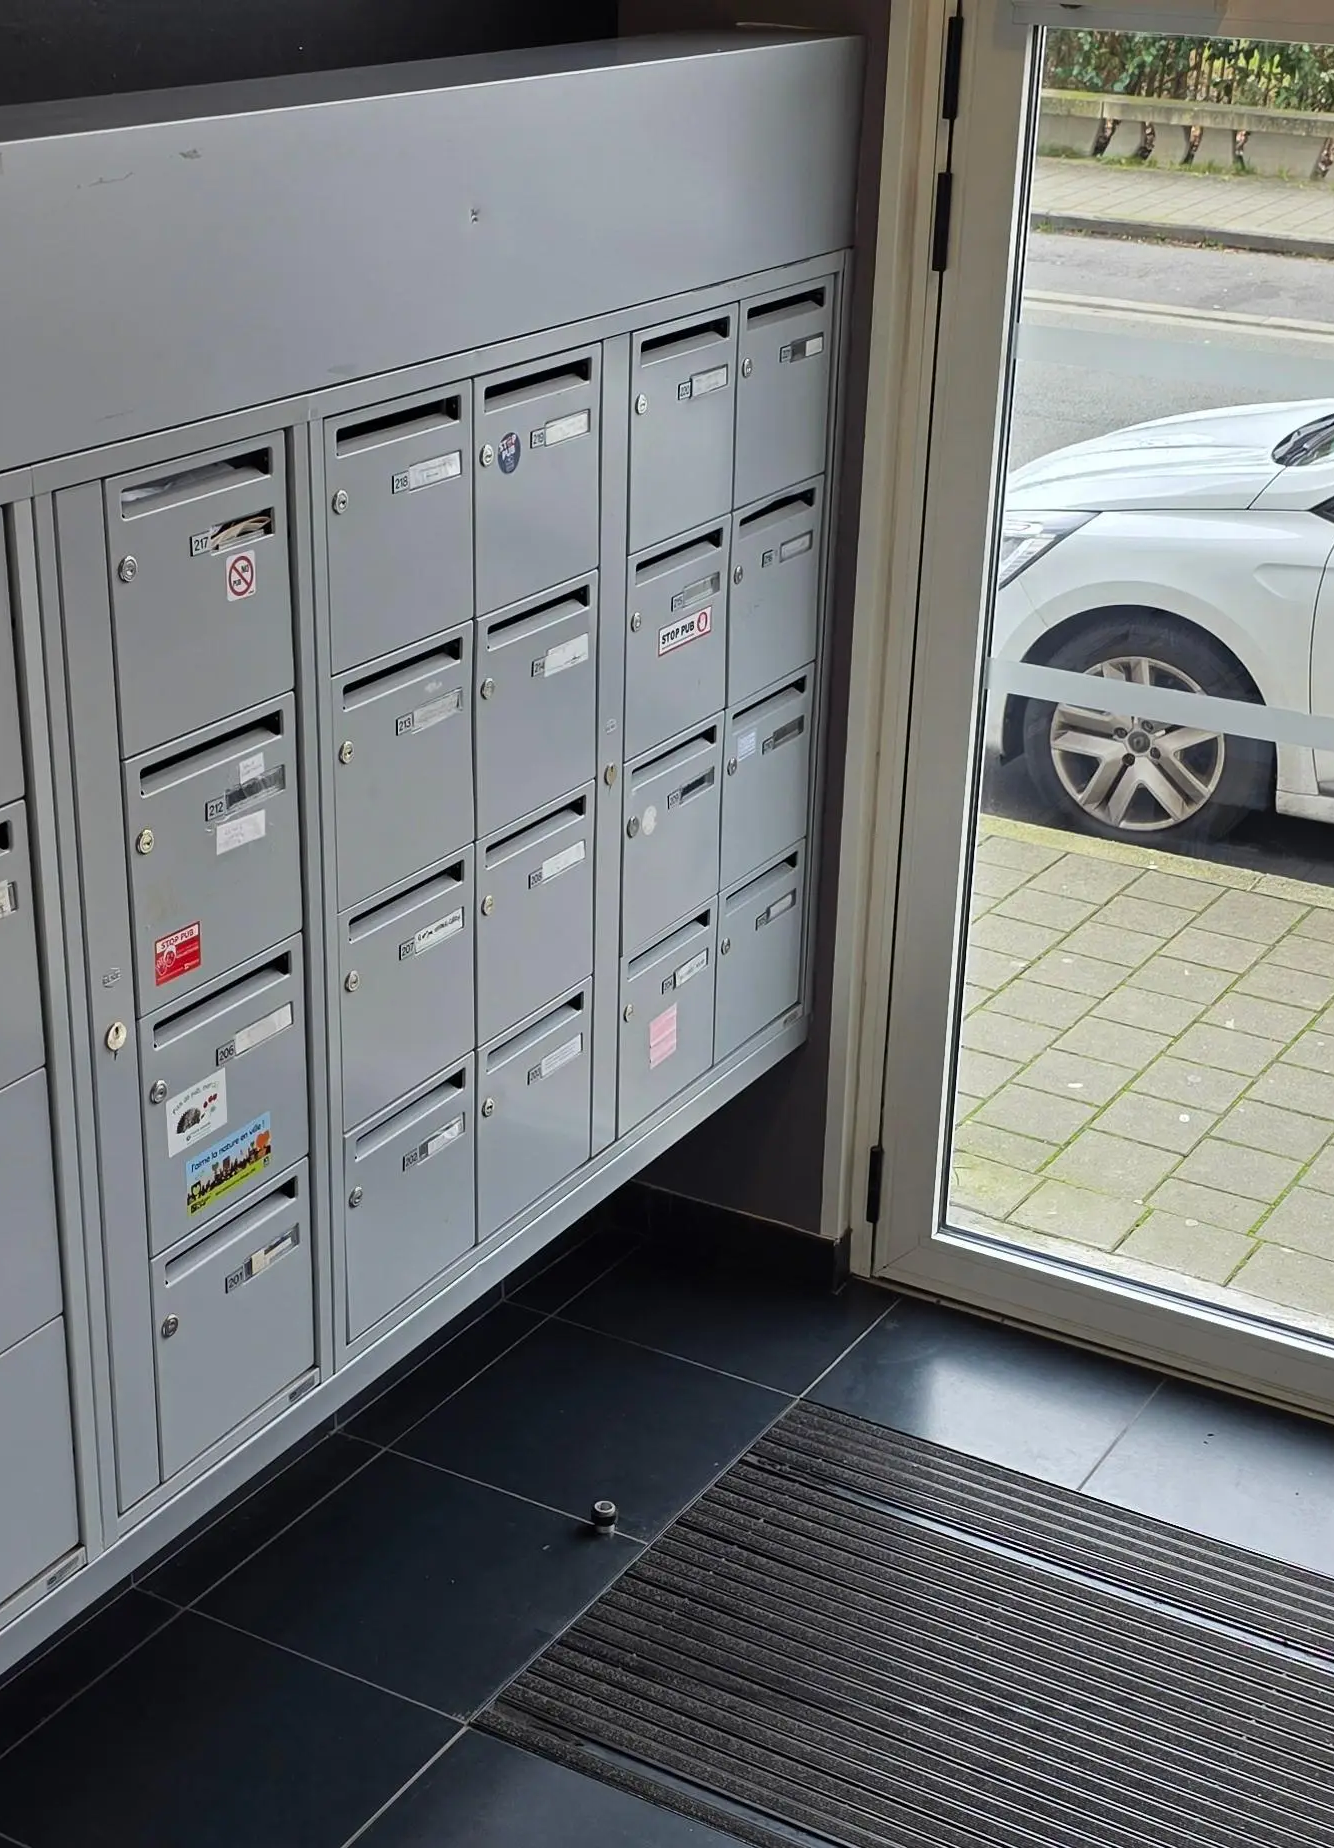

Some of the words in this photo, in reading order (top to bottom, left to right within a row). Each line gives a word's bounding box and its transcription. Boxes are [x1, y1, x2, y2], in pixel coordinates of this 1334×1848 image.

[394, 475, 408, 490] 218
[194, 536, 209, 552] 217
[661, 627, 679, 645] STOP
[681, 620, 695, 636] PUB
[398, 717, 412, 732] 213
[209, 801, 224, 817] 212
[161, 935, 179, 950] STOP
[180, 928, 194, 941] PUB
[401, 942, 414, 957] 207
[219, 1044, 234, 1061] 206
[229, 1271, 243, 1289] 201
